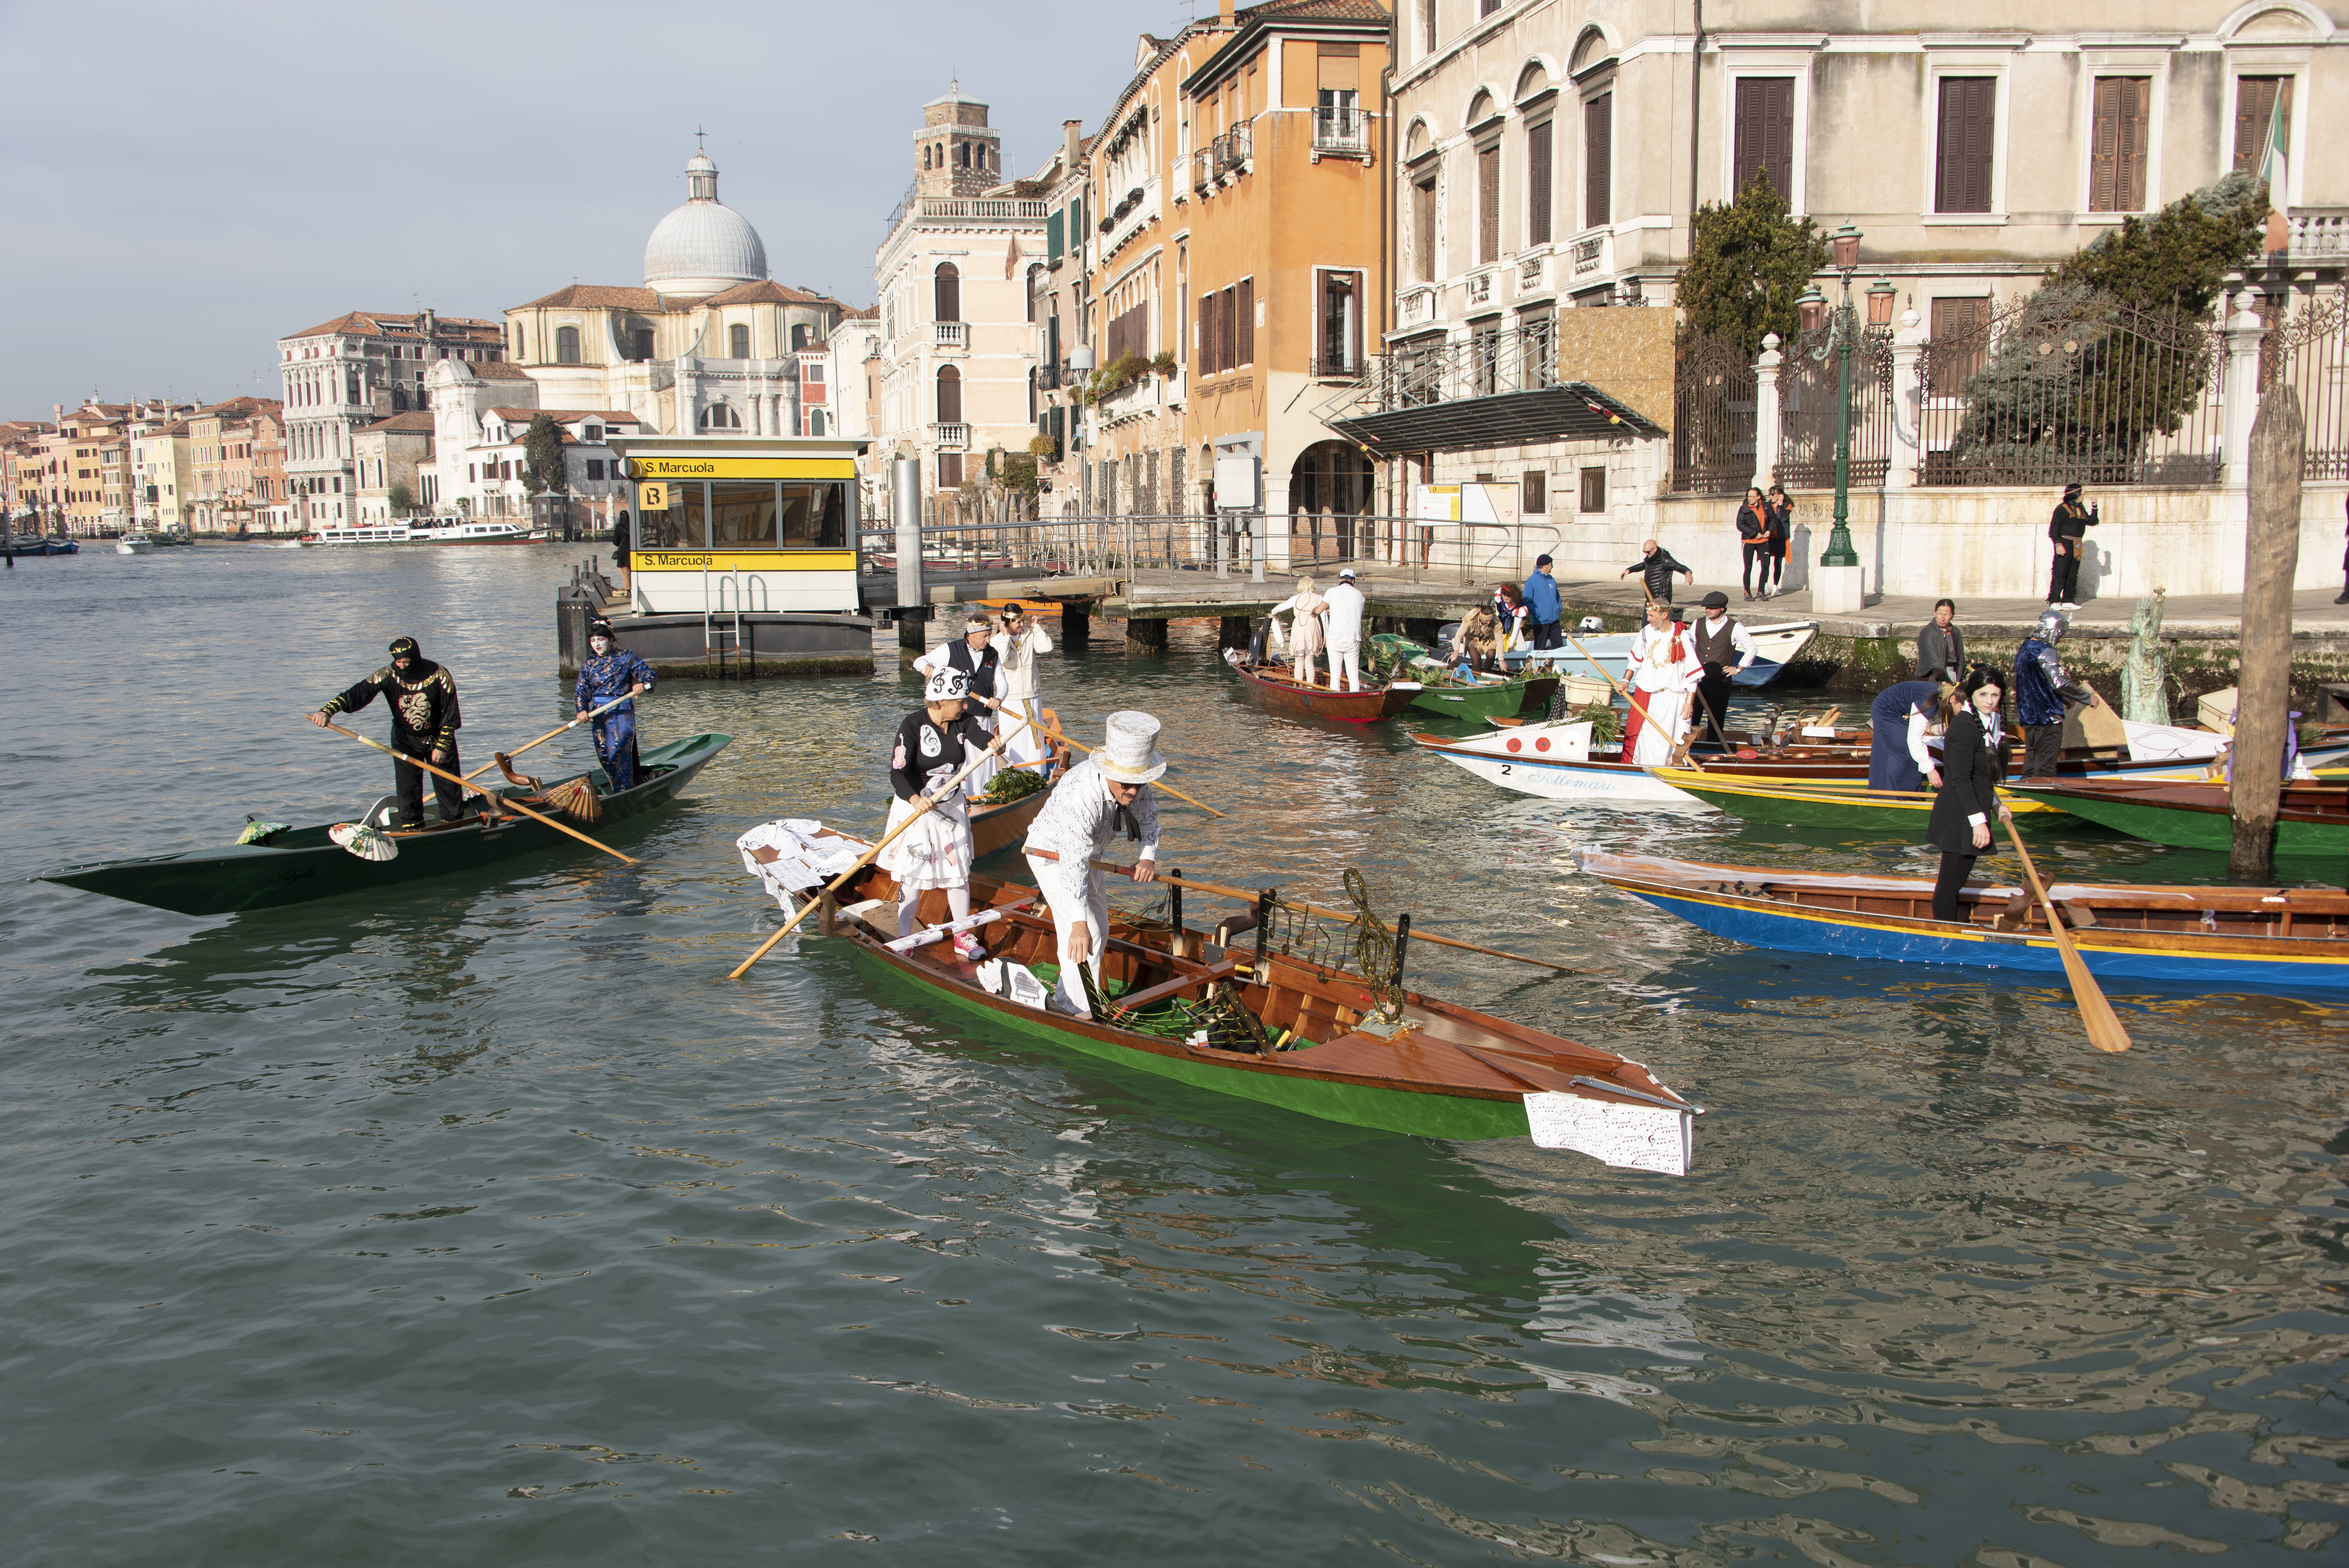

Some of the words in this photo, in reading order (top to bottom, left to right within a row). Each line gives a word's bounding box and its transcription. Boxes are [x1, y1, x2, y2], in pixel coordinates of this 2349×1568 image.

[645, 462, 656, 472] S.
[659, 462, 714, 472] Marcuola
[647, 488, 660, 505] B
[645, 554, 656, 566] S.
[658, 554, 713, 566] Marcuola
[1501, 764, 1511, 775] 2
[1528, 770, 1615, 791] Settemari
[270, 866, 318, 887] Sibylle
